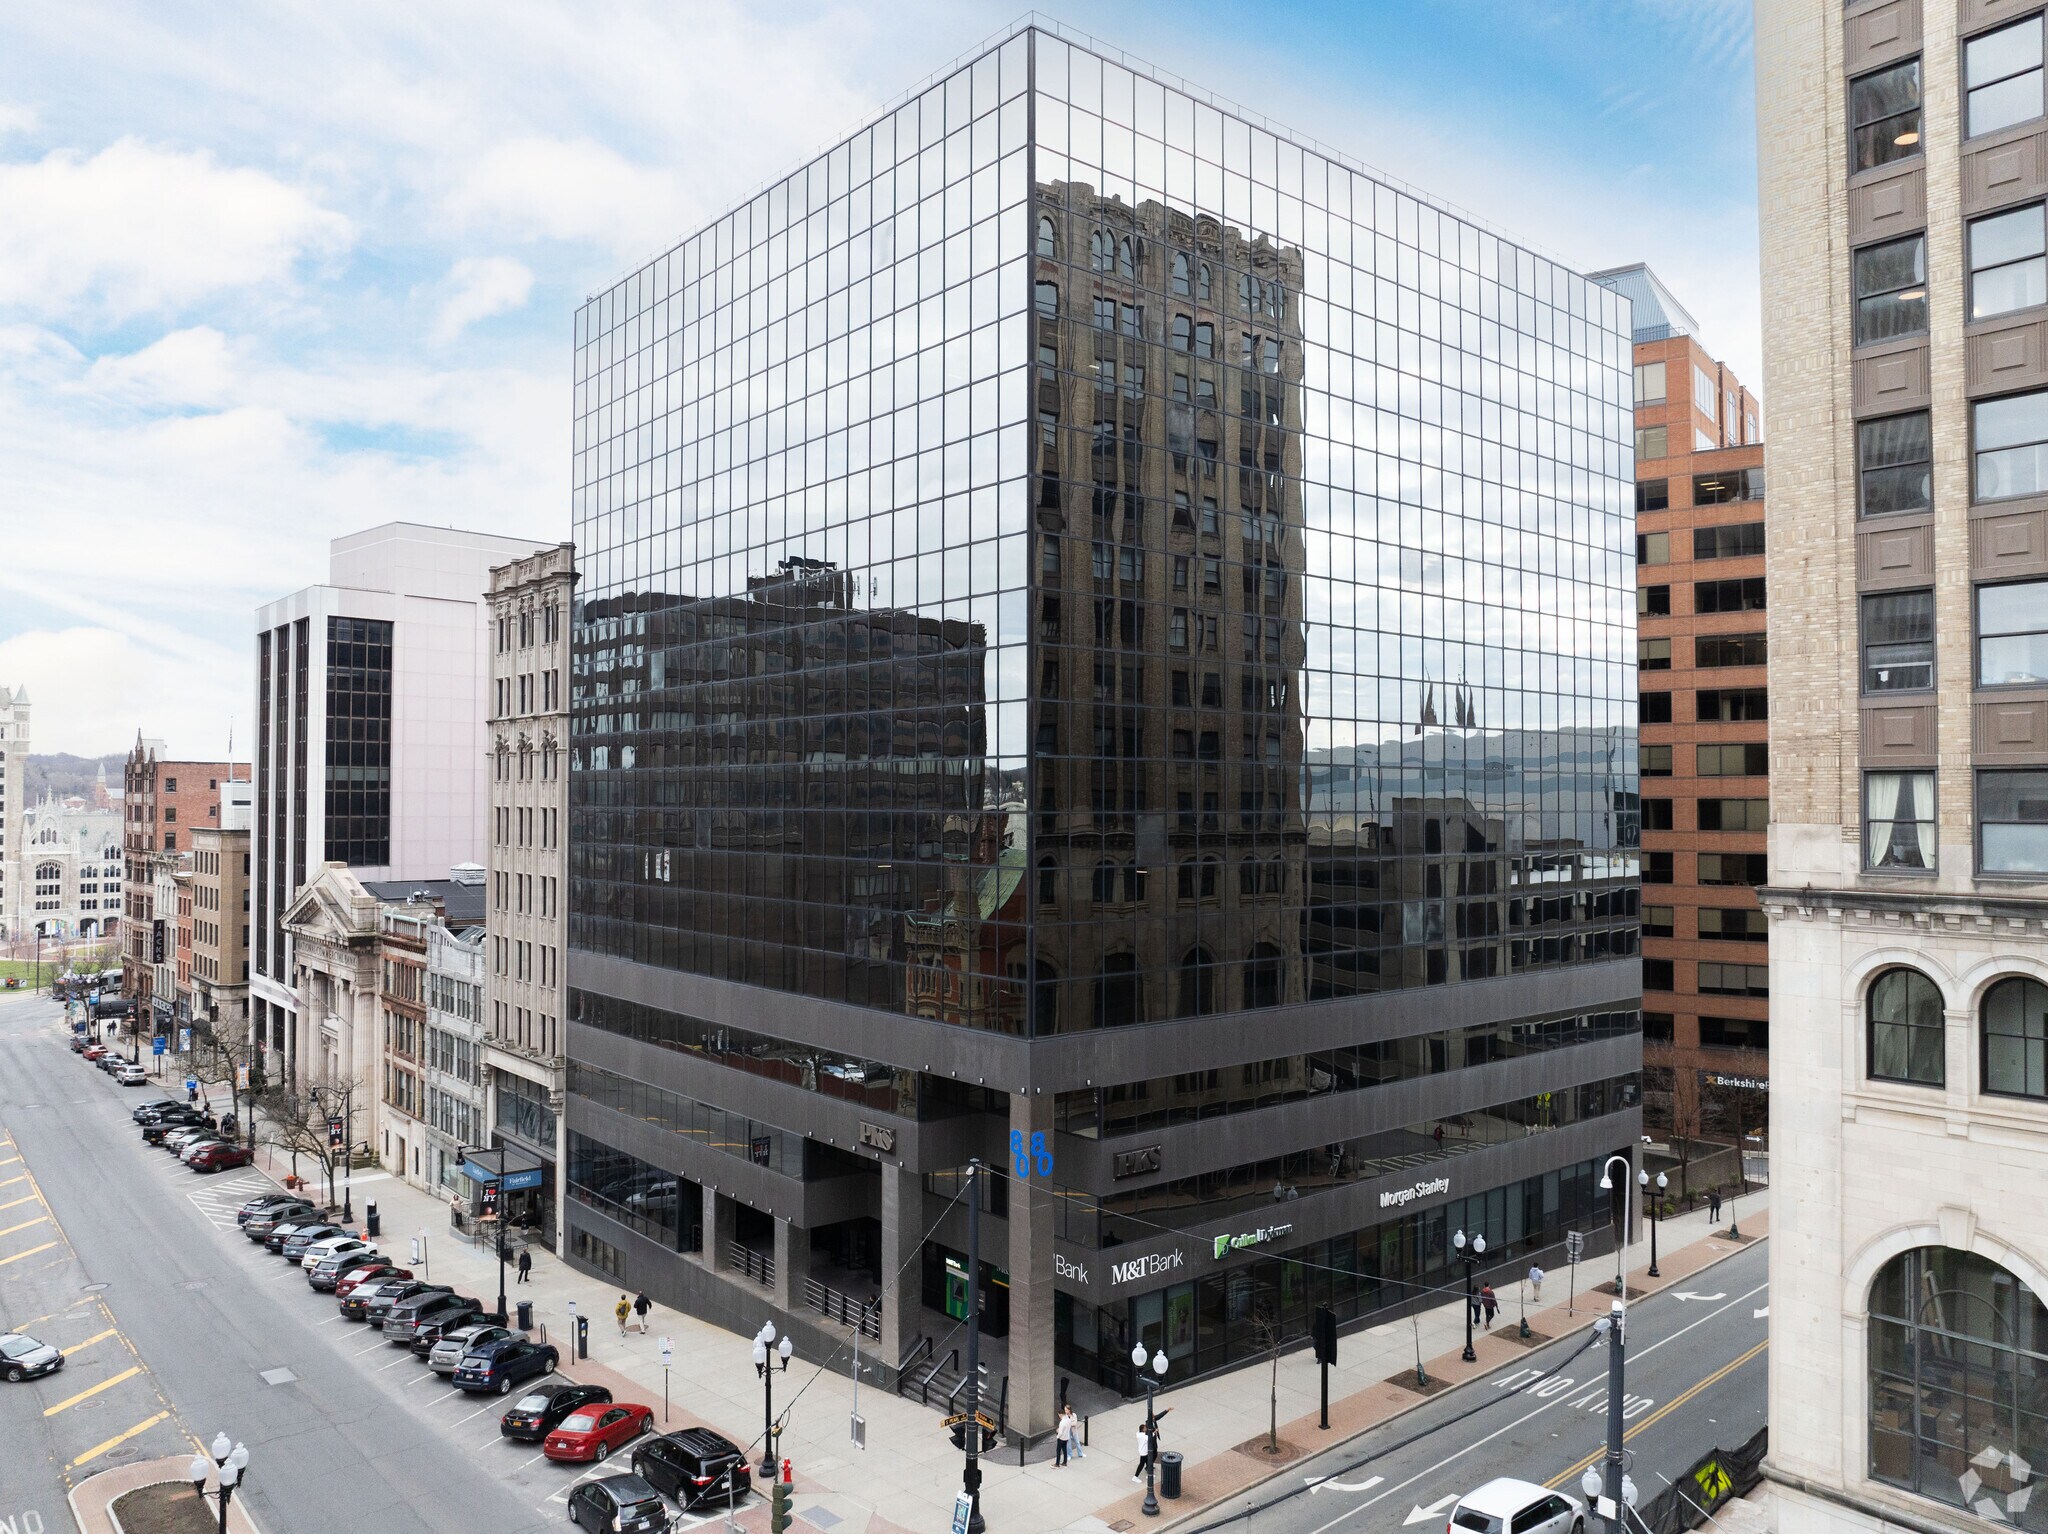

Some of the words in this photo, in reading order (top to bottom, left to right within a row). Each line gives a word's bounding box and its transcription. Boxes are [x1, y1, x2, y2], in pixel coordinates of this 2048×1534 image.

[1380, 1191, 1415, 1208] Morgan
[1415, 1177, 1450, 1198] Stanley
[1055, 1253, 1089, 1285] Bank
[1149, 1248, 1184, 1275] Bank
